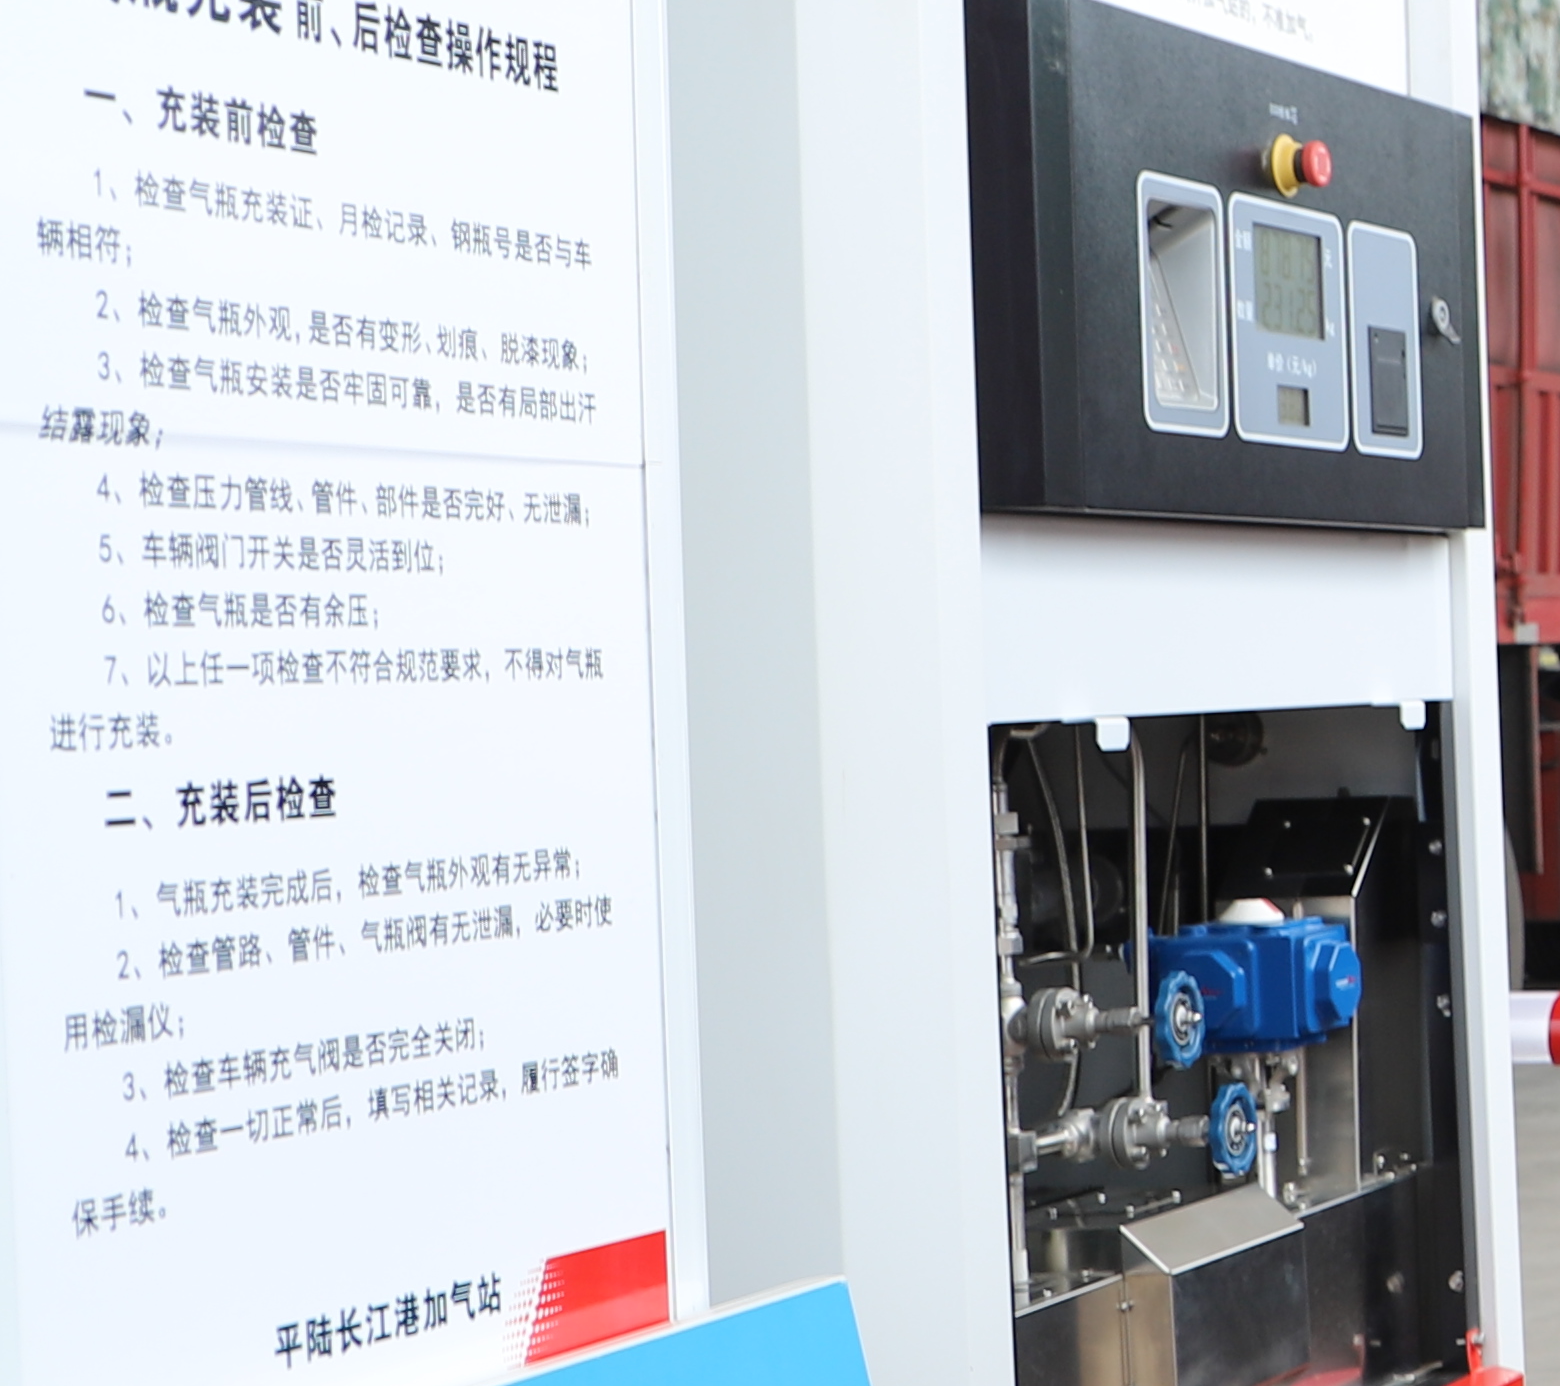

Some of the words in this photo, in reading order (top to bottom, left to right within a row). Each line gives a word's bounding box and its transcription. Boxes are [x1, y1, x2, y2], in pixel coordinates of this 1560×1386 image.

[84, 84, 319, 155] 一、充装前检查
[50, 712, 174, 753] 进行充装。
[105, 774, 337, 830] 二、充装后检查
[72, 1186, 167, 1240] 保手续。
[274, 1271, 502, 1369] 平陆长江港加气站
